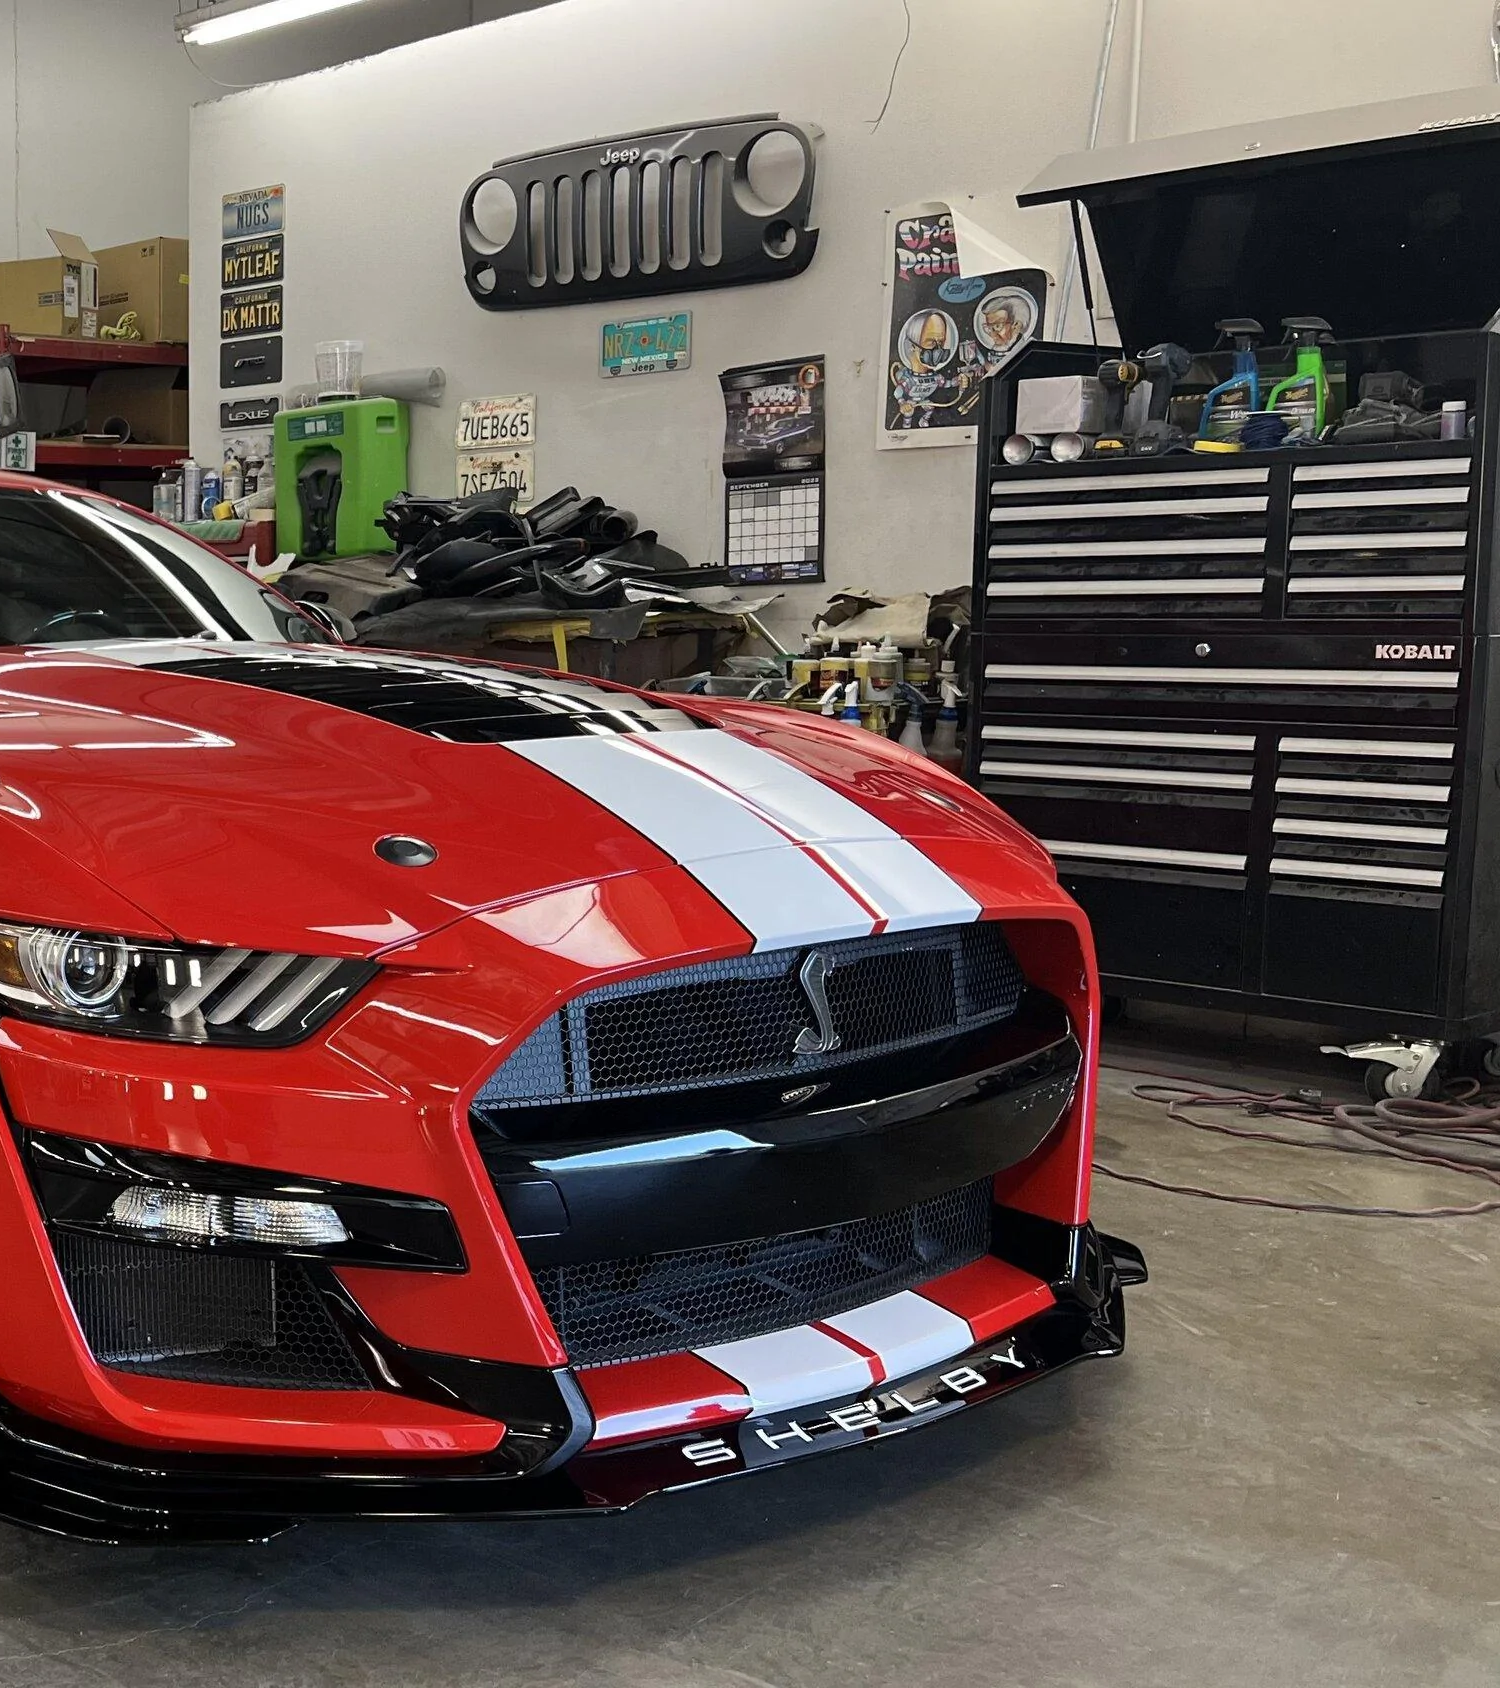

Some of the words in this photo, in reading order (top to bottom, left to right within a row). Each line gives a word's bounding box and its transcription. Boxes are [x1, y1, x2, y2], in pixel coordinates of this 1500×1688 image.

[600, 147, 640, 166] Jeep
[239, 190, 268, 203] NEVADA
[236, 202, 269, 229] NUGS
[235, 242, 269, 255] CALIFORNIA
[224, 248, 280, 282] MYTLEAF
[234, 292, 268, 304] CALIFORNIA
[222, 308, 238, 332] DK
[240, 302, 280, 329] MATTR
[621, 356, 639, 365] NEW
[639, 352, 668, 362] MEXICO
[631, 363, 655, 373] Jeep
[228, 409, 269, 421] LEXUS
[474, 401, 516, 415] California
[462, 413, 529, 441] 7UEB665
[729, 482, 769, 491] SEPTEMBER
[1375, 644, 1455, 660] KOBALT
[682, 1337, 1026, 1467] SHELBY
